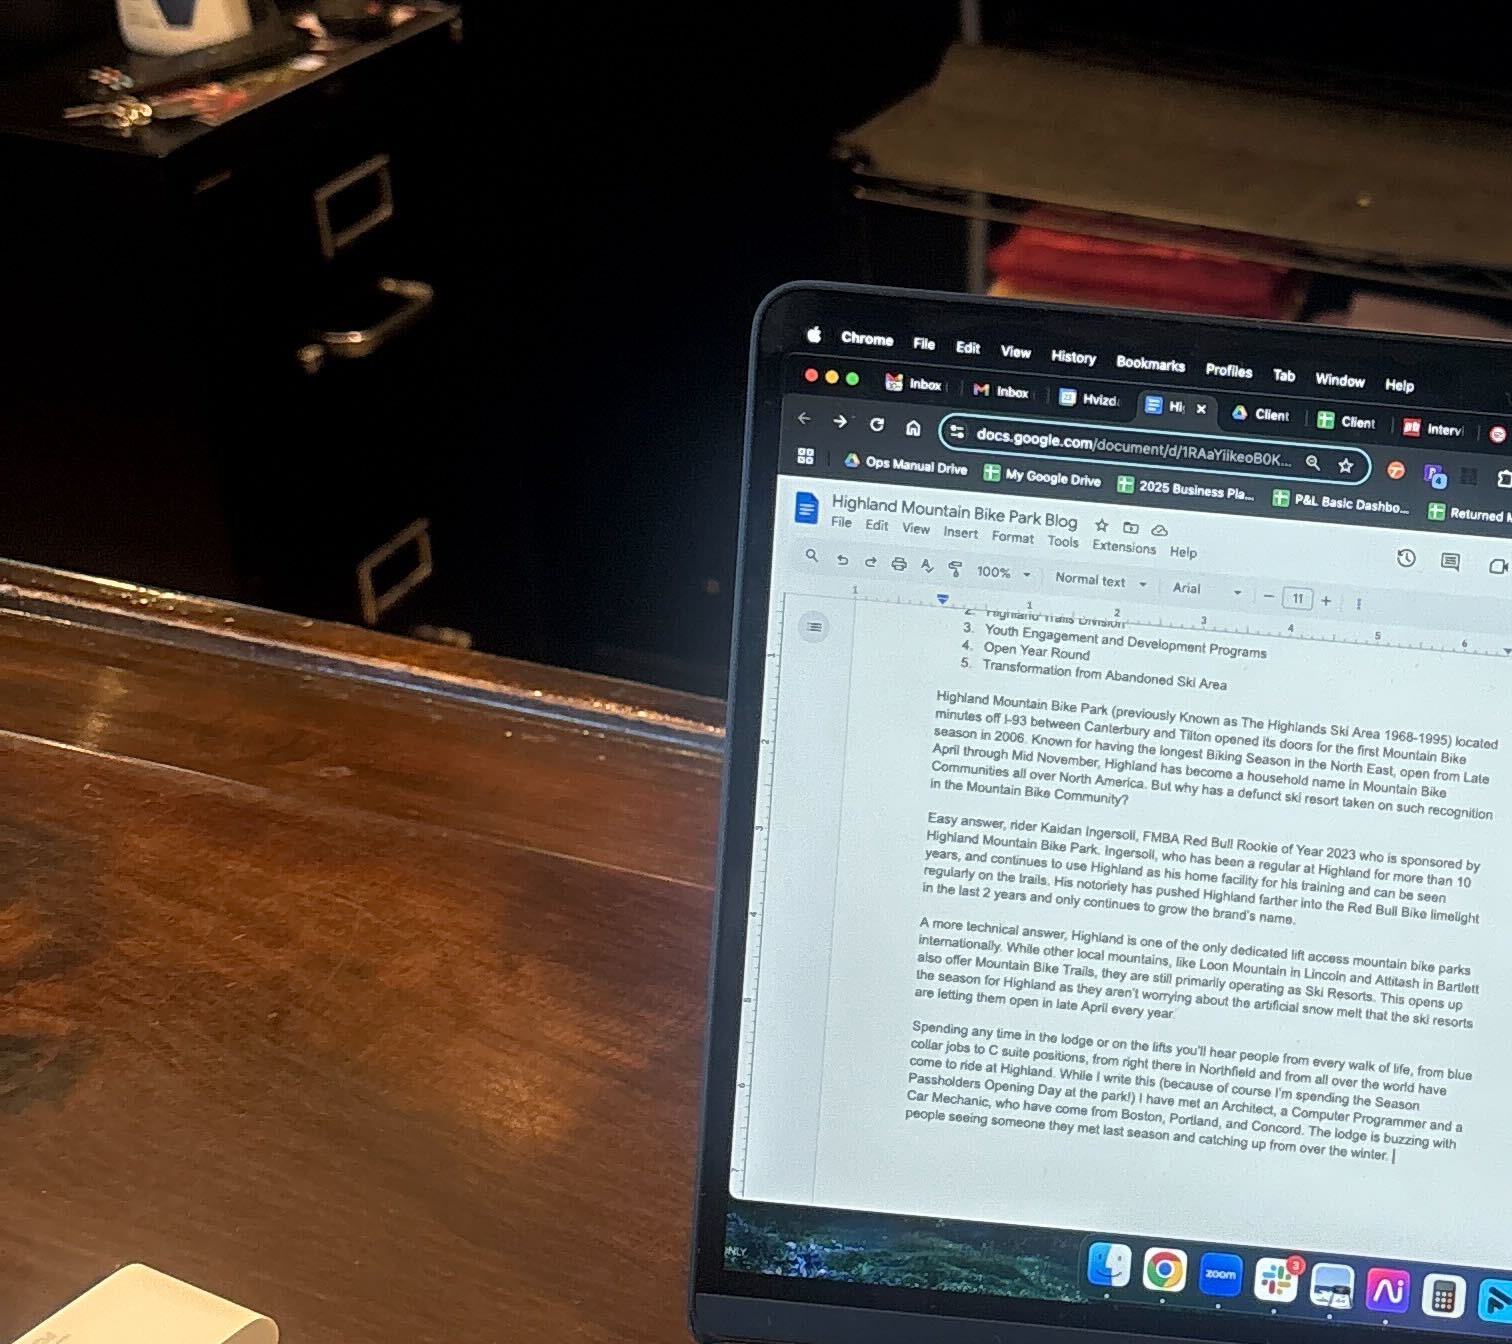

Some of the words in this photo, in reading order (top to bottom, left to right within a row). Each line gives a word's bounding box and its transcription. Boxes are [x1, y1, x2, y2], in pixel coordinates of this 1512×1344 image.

[841, 330, 895, 347] Chrome
[913, 336, 936, 351] File
[956, 340, 981, 355] Edit
[1000, 344, 1032, 359] View
[1051, 349, 1098, 367] History
[1116, 354, 1186, 373] Bookmarks
[1205, 362, 1253, 379] Profiles
[1273, 368, 1296, 383] Tab
[1315, 372, 1366, 389] Window
[1385, 378, 1415, 395] Help
[832, 493, 898, 513] Highland
[901, 500, 971, 519] Mountain
[974, 506, 1006, 523] Bike
[1008, 509, 1042, 526] Park
[1045, 512, 1078, 533] Blog
[831, 515, 853, 529] File
[865, 518, 889, 532] Edit
[902, 521, 931, 535] View
[943, 525, 979, 540] Insert
[991, 529, 1035, 545] Format
[1047, 534, 1080, 549] Tools
[1092, 538, 1157, 555] Extensions
[1170, 545, 1198, 561] Help
[983, 641, 1017, 656] Open
[1020, 644, 1049, 657] Year
[1050, 646, 1091, 661] Round
[985, 623, 1019, 637] Youth
[1022, 626, 1099, 645] Engagement
[1101, 635, 1125, 647] and
[1127, 635, 1206, 654] Development
[1209, 643, 1267, 659] Programs
[982, 658, 1072, 677] Transformation
[1075, 666, 1102, 680] from
[1104, 669, 1174, 686] Abandoned
[1176, 675, 1196, 688] Ski
[1198, 677, 1228, 691] Area
